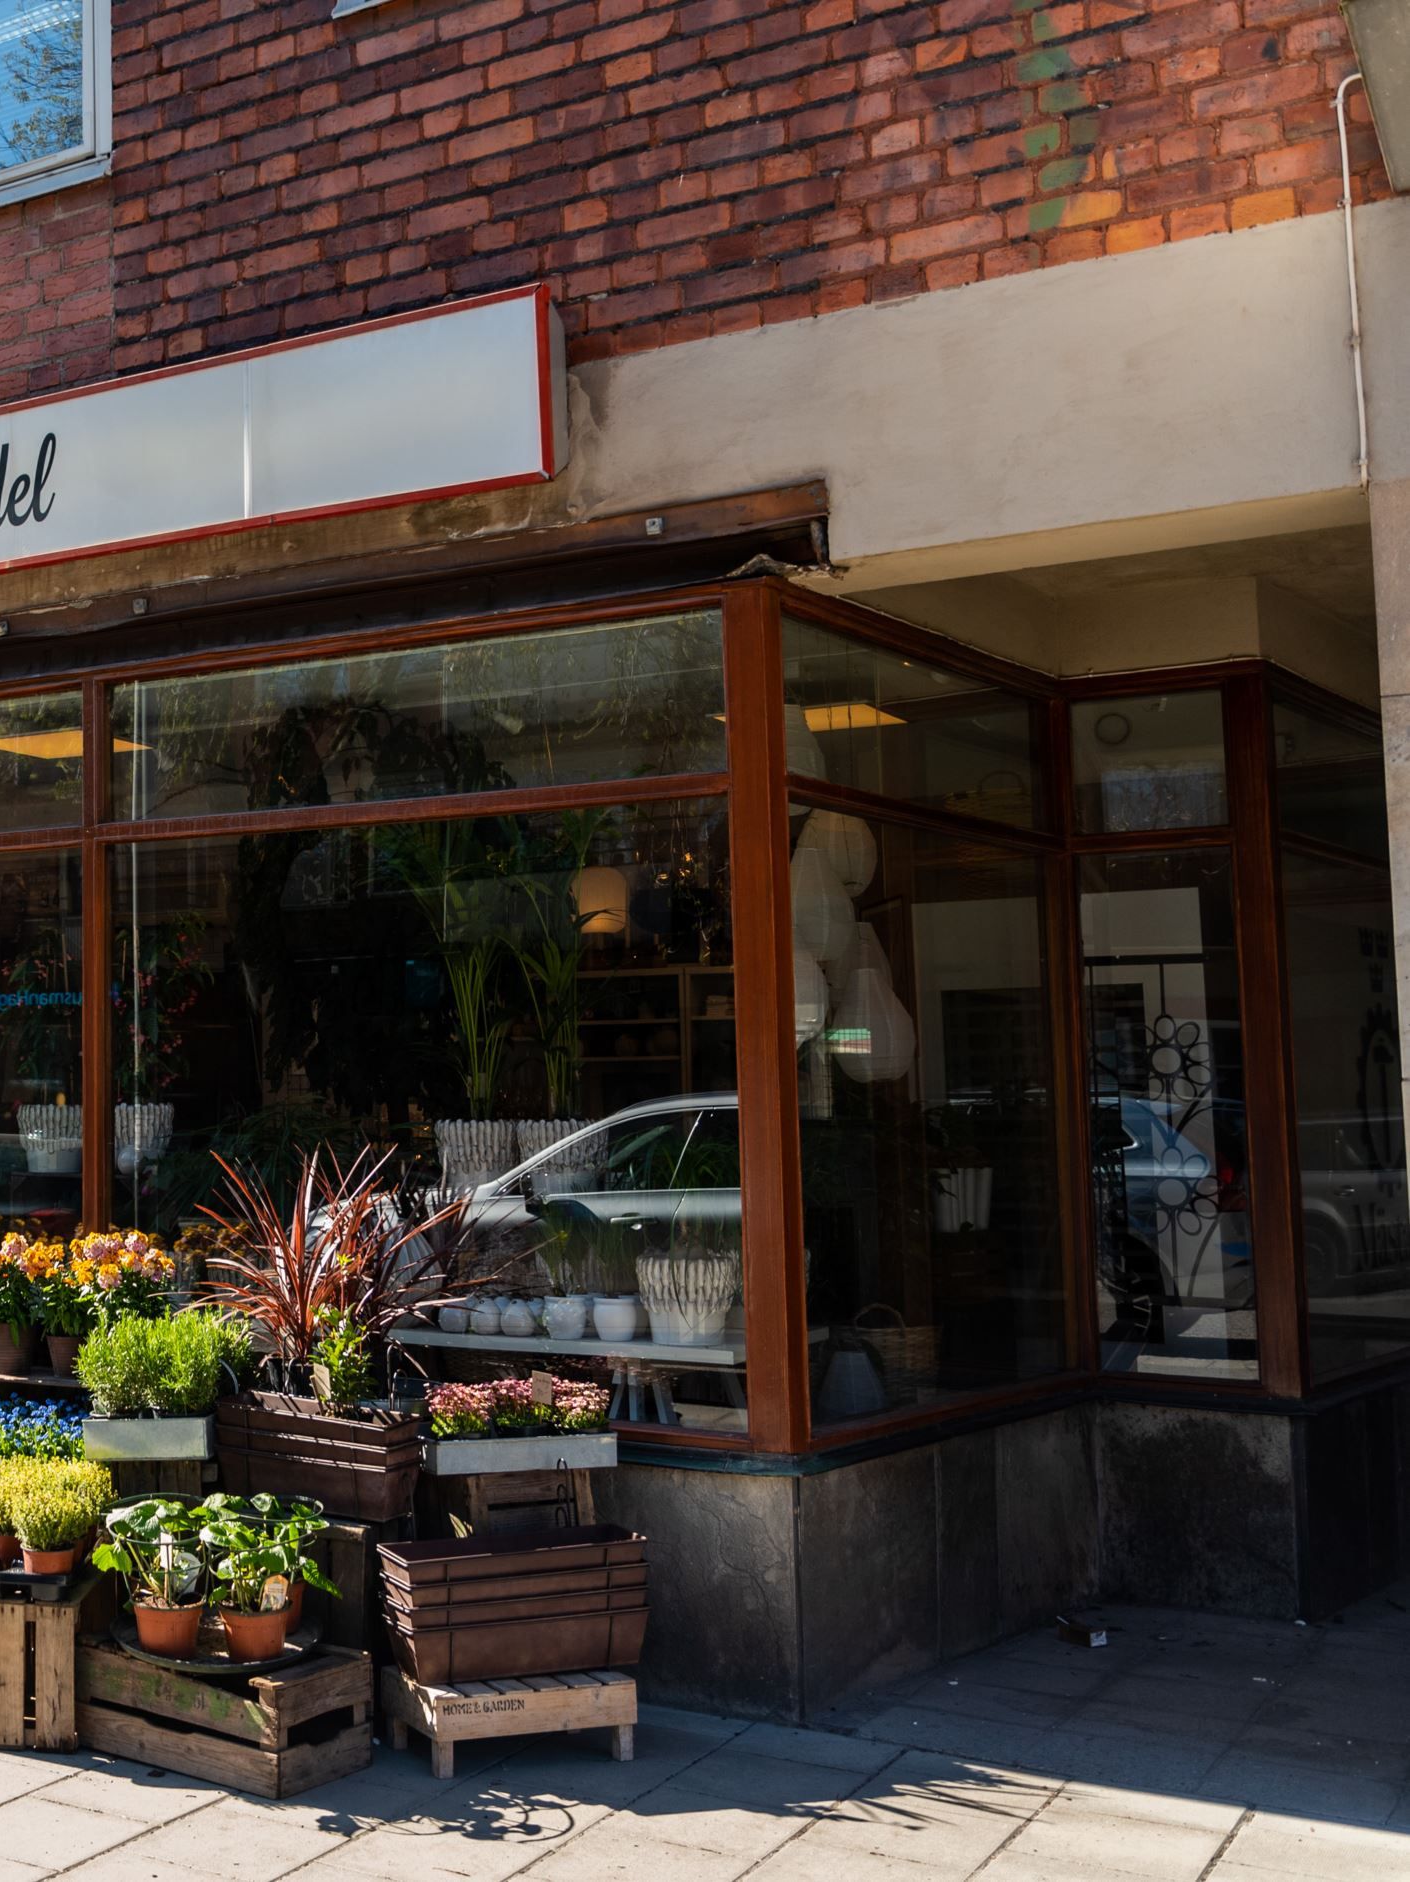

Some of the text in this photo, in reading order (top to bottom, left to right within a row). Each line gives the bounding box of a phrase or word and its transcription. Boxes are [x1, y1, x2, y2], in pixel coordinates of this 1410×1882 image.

[442, 1699, 525, 1716] HOME & GARDEN
